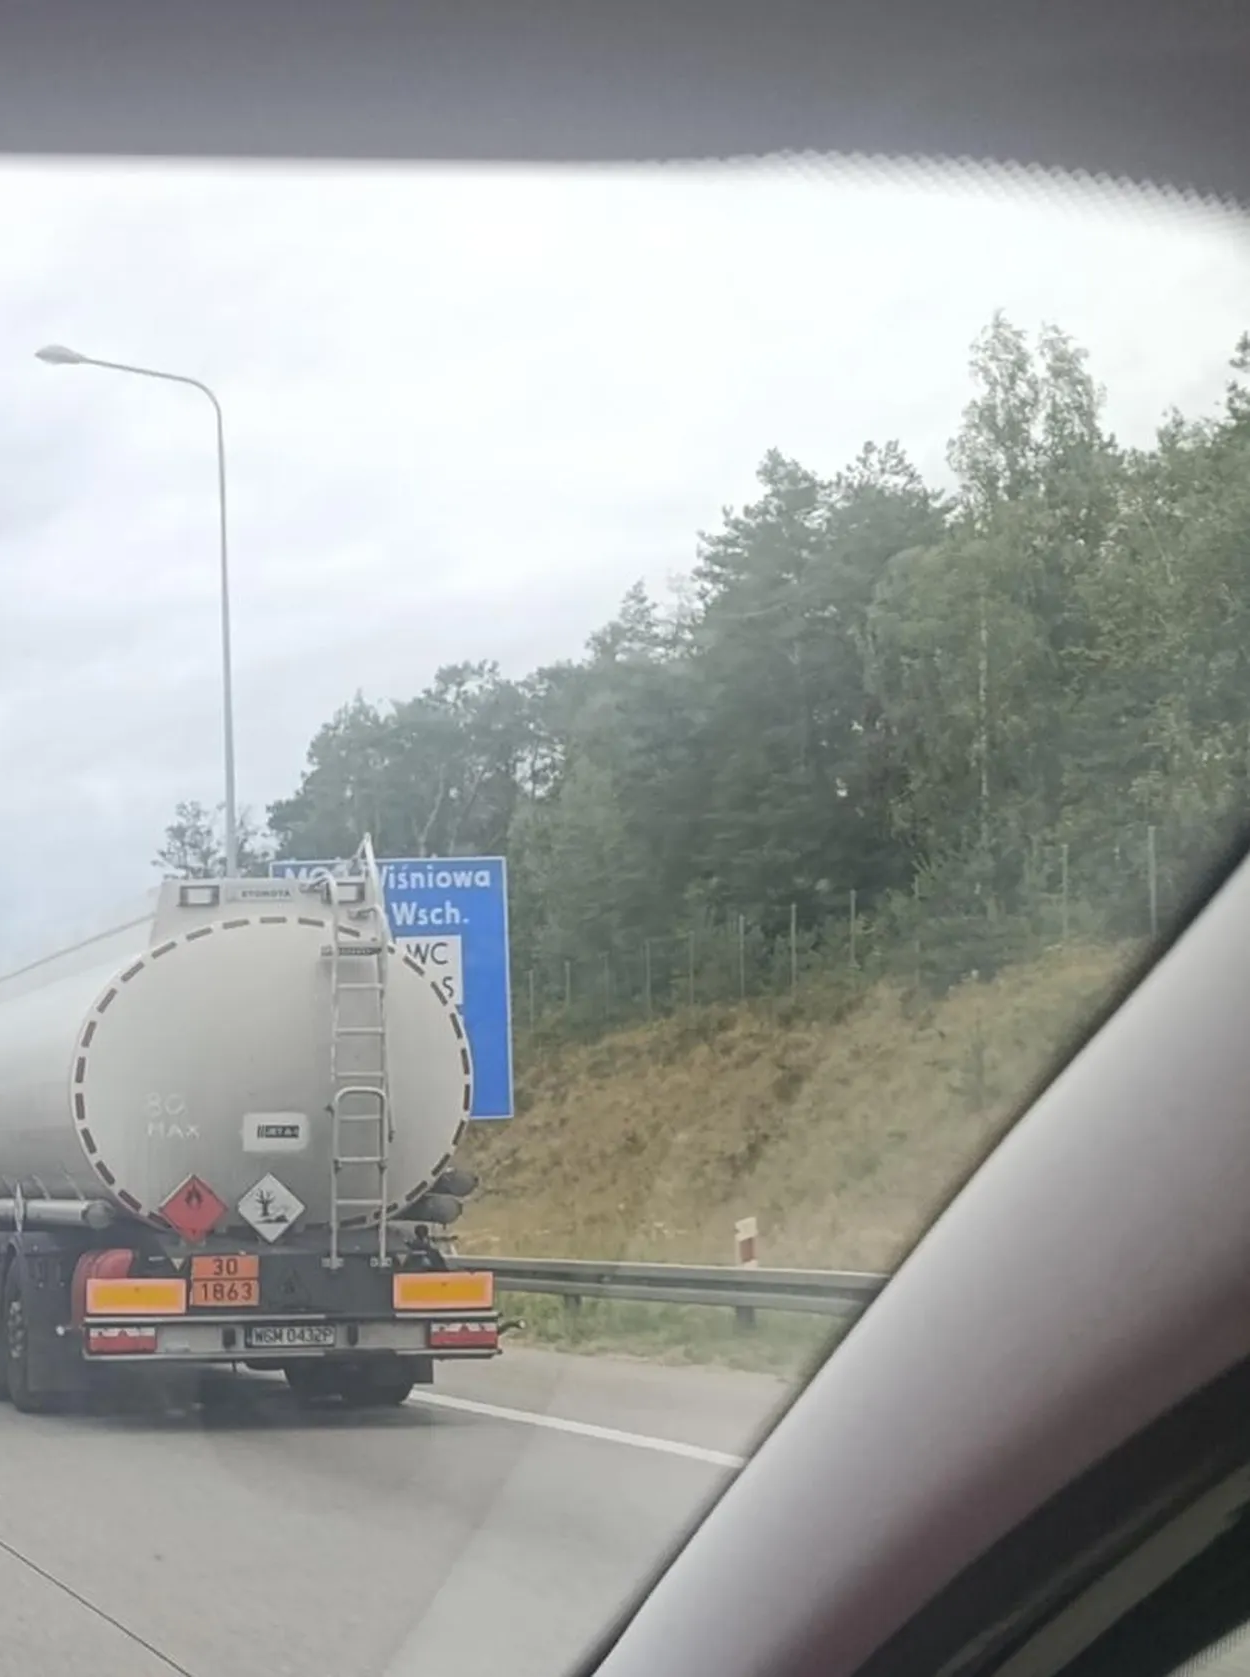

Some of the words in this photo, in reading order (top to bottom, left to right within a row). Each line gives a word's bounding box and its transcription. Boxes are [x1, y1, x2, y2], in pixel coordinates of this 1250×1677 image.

[381, 864, 491, 889] iśniowa
[391, 900, 470, 926] Wsch.
[406, 941, 449, 965] WC
[213, 1258, 239, 1276] 30
[201, 1282, 253, 1301] 1863
